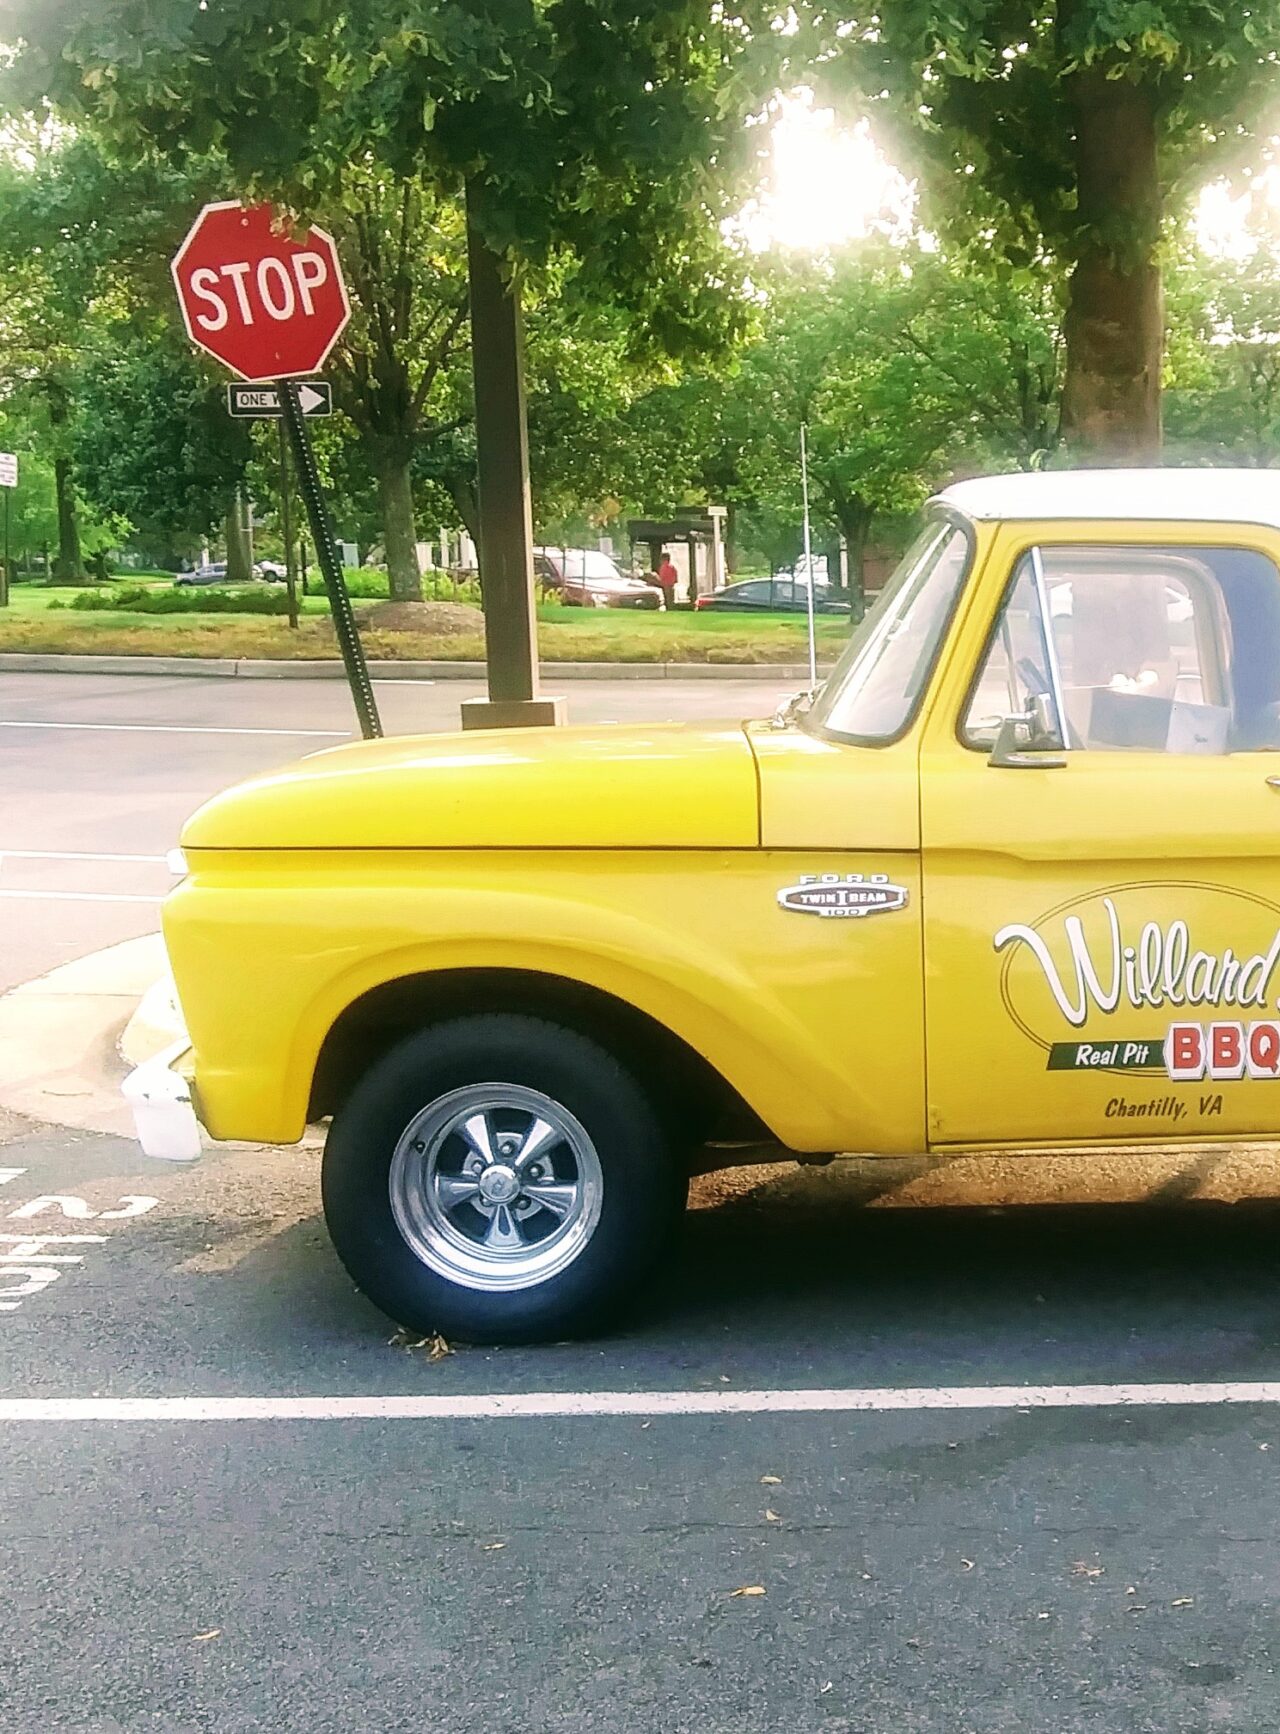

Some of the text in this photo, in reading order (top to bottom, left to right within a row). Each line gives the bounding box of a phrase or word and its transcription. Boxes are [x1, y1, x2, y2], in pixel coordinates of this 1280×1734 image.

[190, 251, 327, 331] STOP
[240, 393, 267, 406] ONE
[799, 873, 889, 885] FORD
[800, 893, 836, 904] TWIN
[848, 892, 887, 903] BEAM
[827, 908, 860, 916] 100
[1075, 1023, 1280, 1074] Real Pit BBQ
[1104, 1095, 1223, 1121] Chantilly, VA
